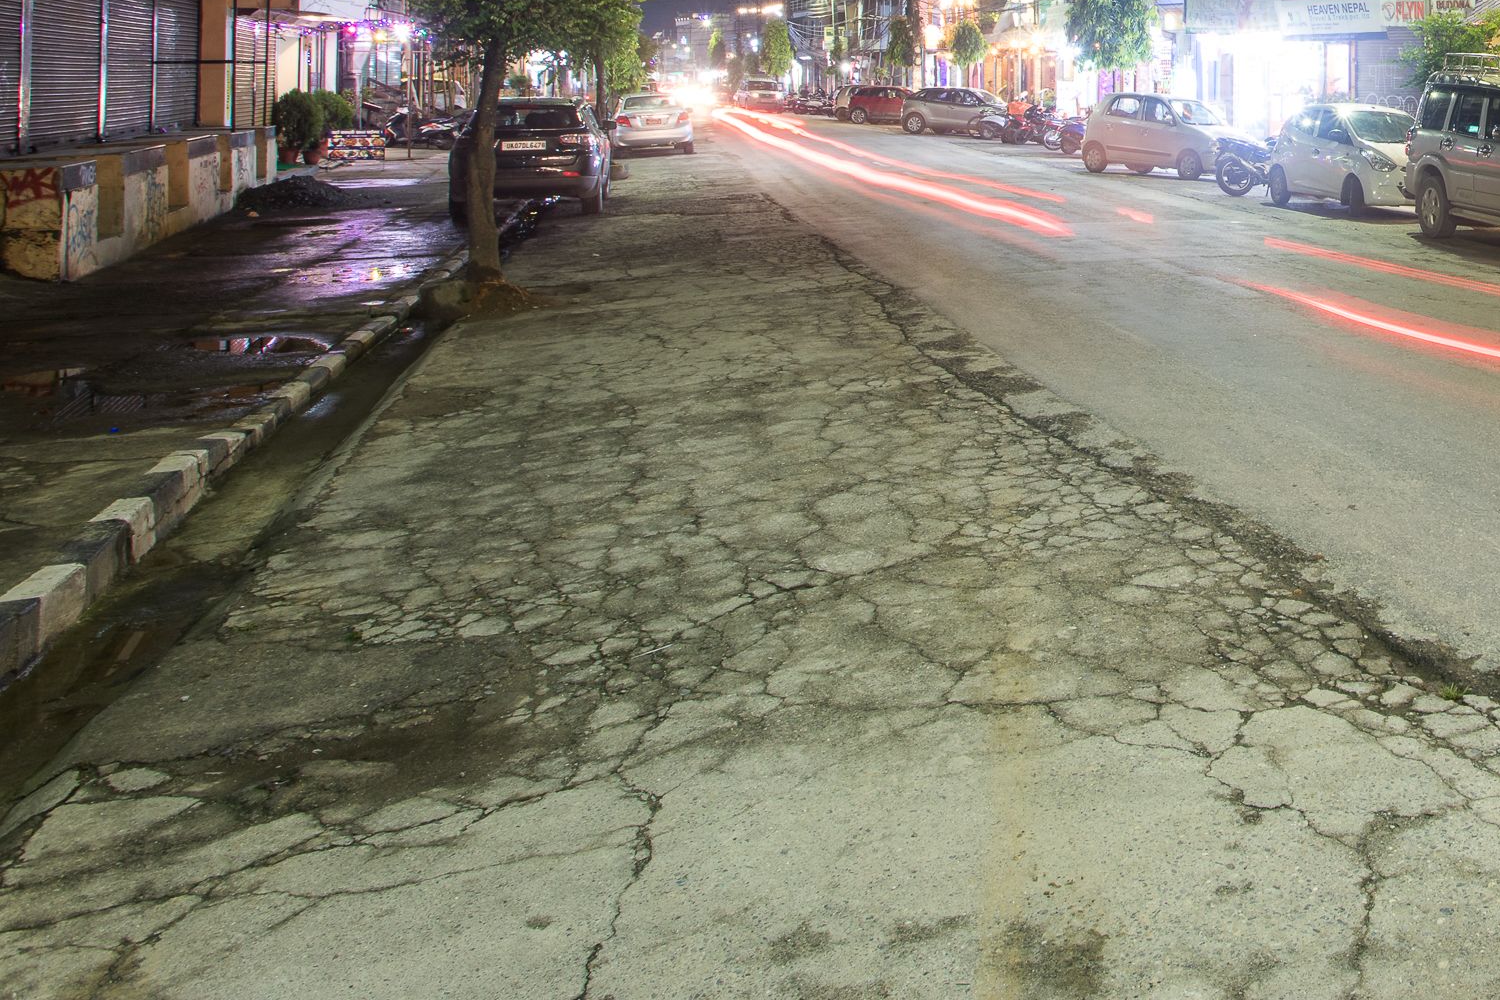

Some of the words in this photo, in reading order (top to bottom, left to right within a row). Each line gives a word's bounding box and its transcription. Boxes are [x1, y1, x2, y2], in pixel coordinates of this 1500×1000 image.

[1307, 3, 1340, 16] HEAVEN
[1341, 1, 1370, 14] NEPAL
[1395, 0, 1431, 20] FLYIN
